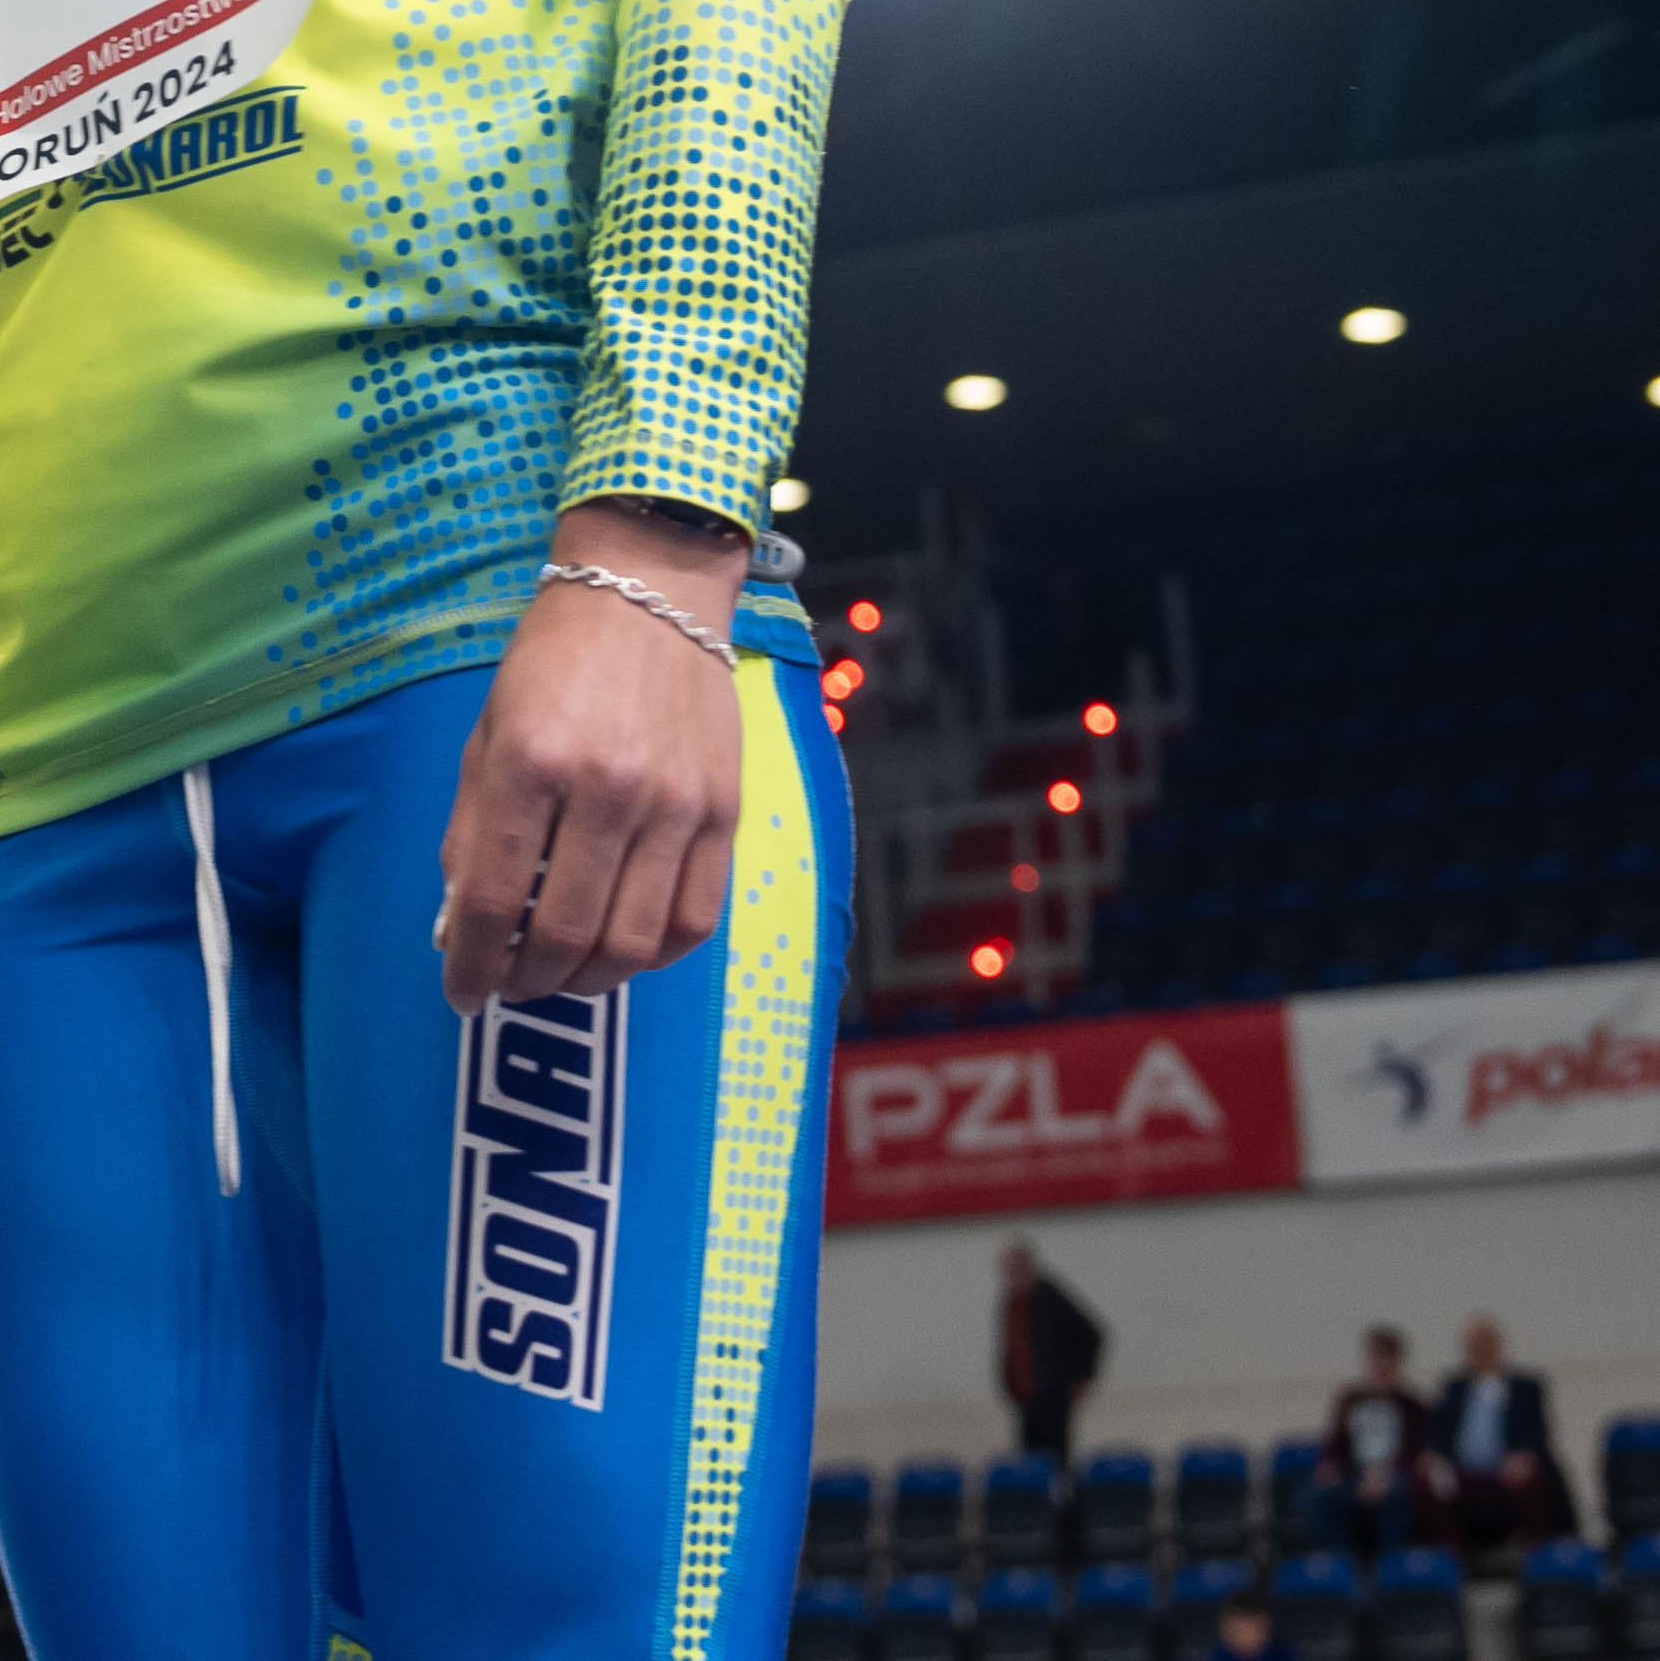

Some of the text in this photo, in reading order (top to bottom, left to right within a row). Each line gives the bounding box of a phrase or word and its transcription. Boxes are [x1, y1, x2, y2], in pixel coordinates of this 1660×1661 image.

[133, 39, 238, 124] 2024
[844, 1037, 1229, 1161] PZLA
[464, 988, 613, 1394] SONA
